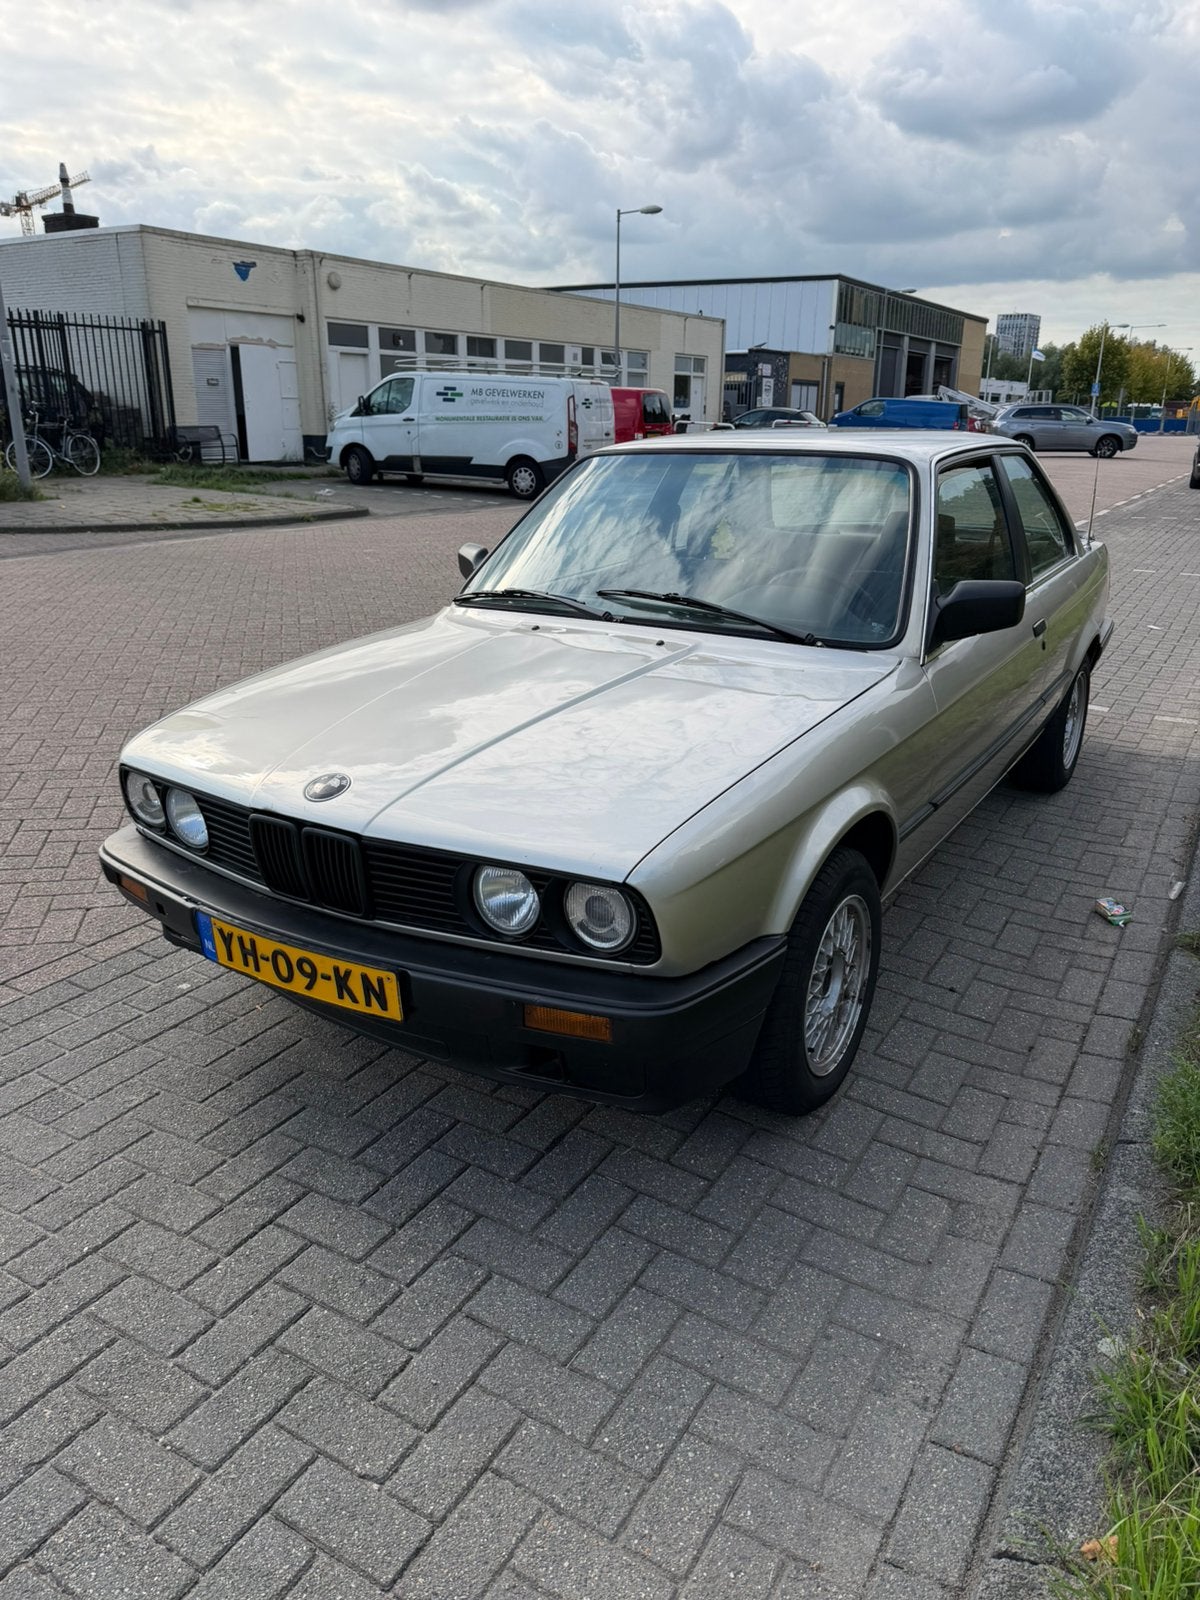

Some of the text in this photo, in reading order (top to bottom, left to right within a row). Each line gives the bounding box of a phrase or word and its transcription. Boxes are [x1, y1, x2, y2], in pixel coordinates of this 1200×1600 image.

[471, 388, 545, 399] MB GEVELWERKEN
[204, 938, 216, 953] NL
[216, 926, 389, 1012] YH-09-KN
